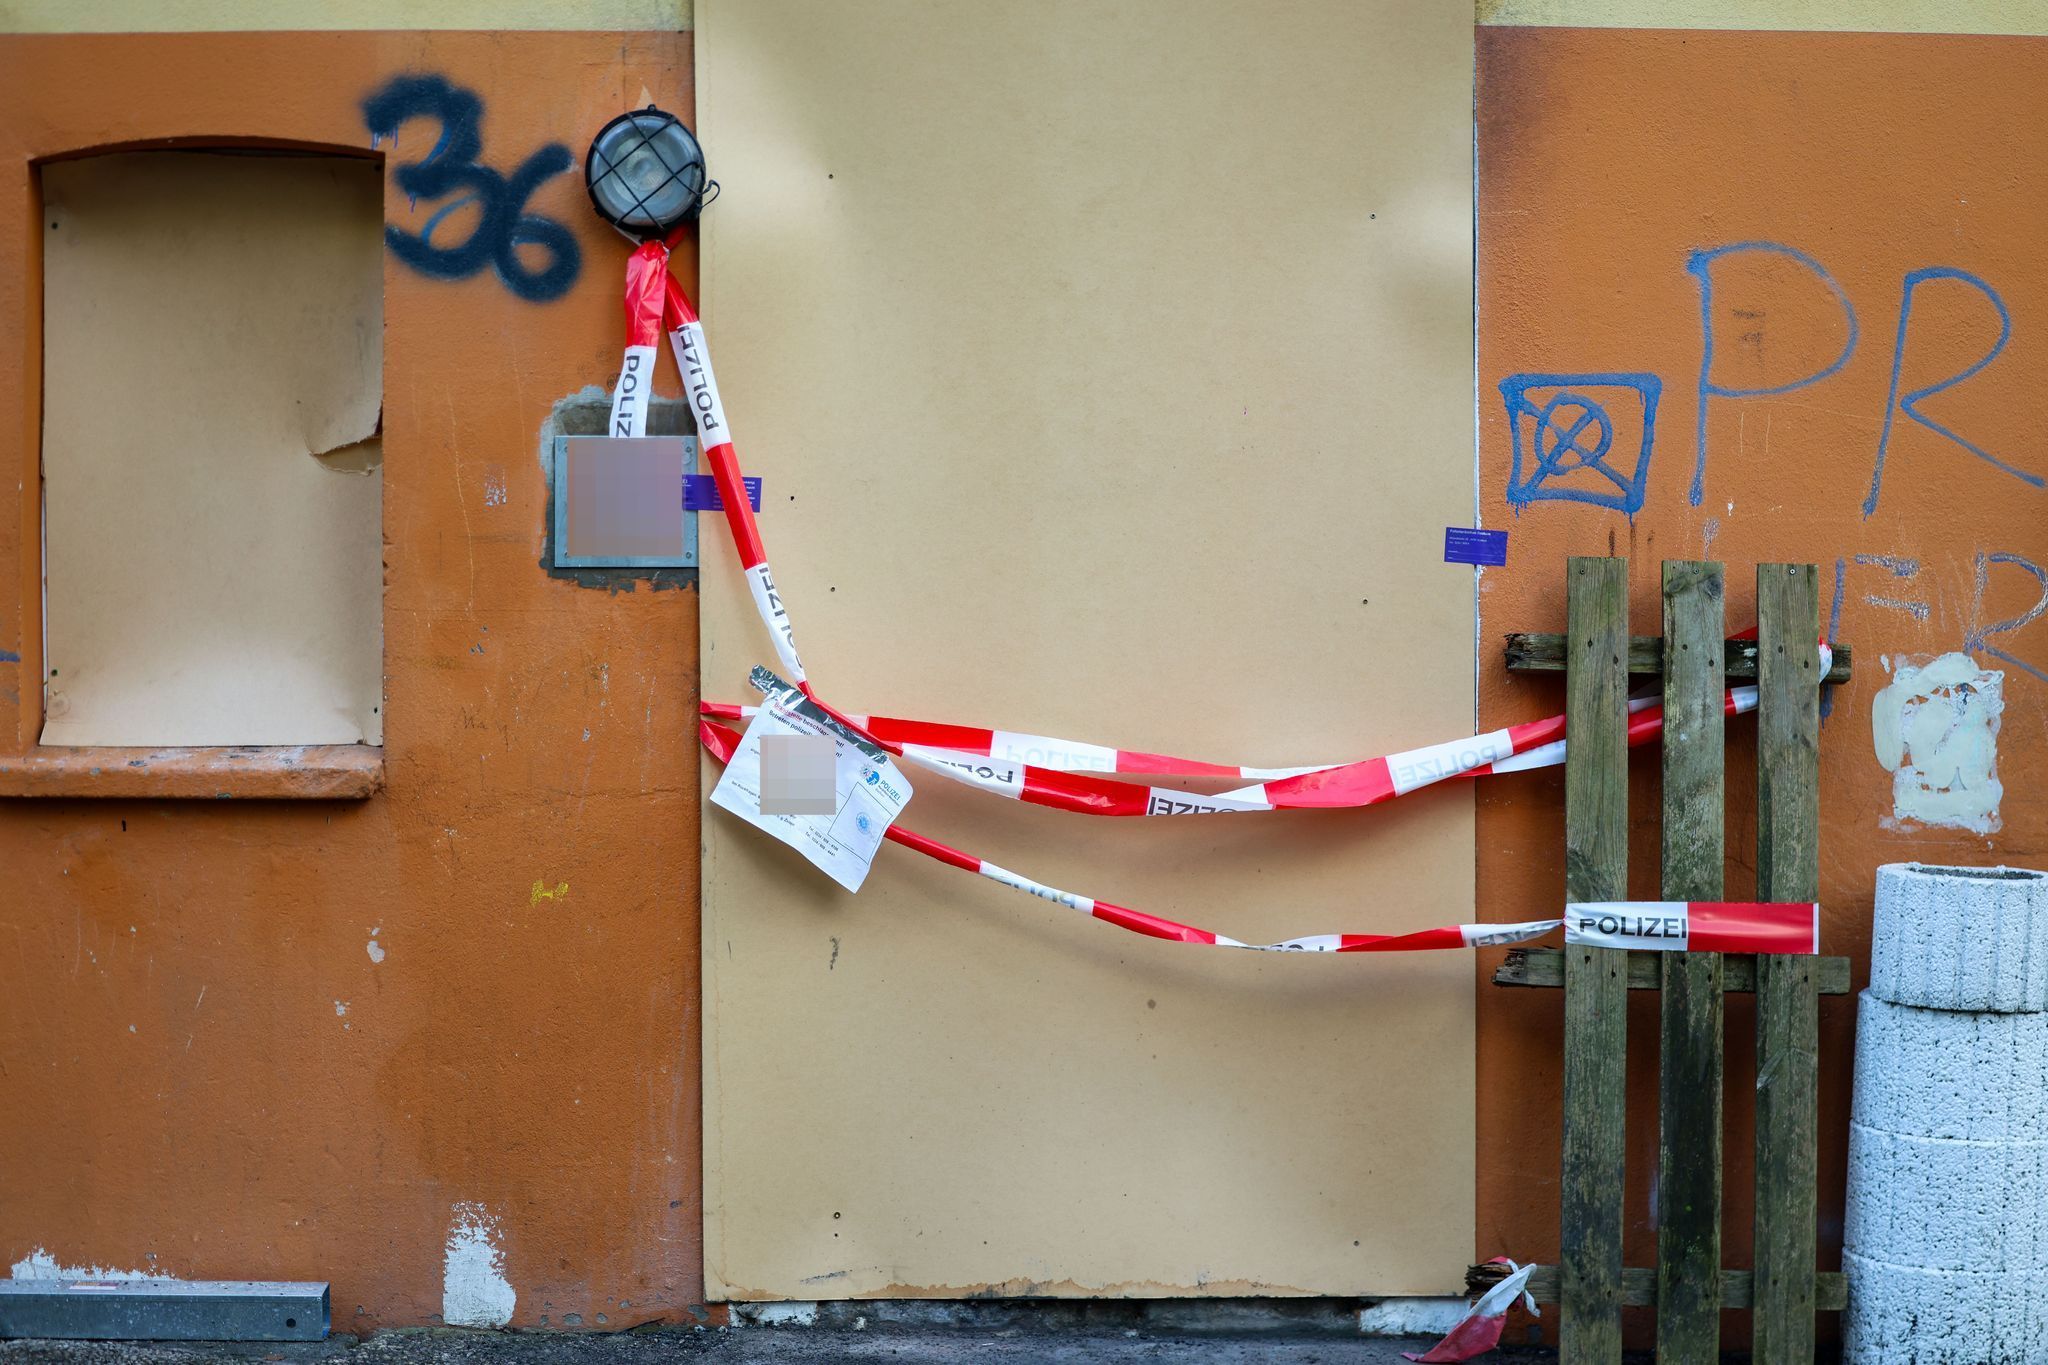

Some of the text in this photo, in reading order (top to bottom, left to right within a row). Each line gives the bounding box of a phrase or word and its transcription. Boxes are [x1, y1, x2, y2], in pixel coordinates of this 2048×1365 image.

[362, 74, 582, 304] 36
[615, 355, 641, 437] POLIZ
[677, 325, 720, 431] POLIZEI
[880, 780, 901, 801] POLIZEI
[1579, 916, 1687, 938] POLIZEI
